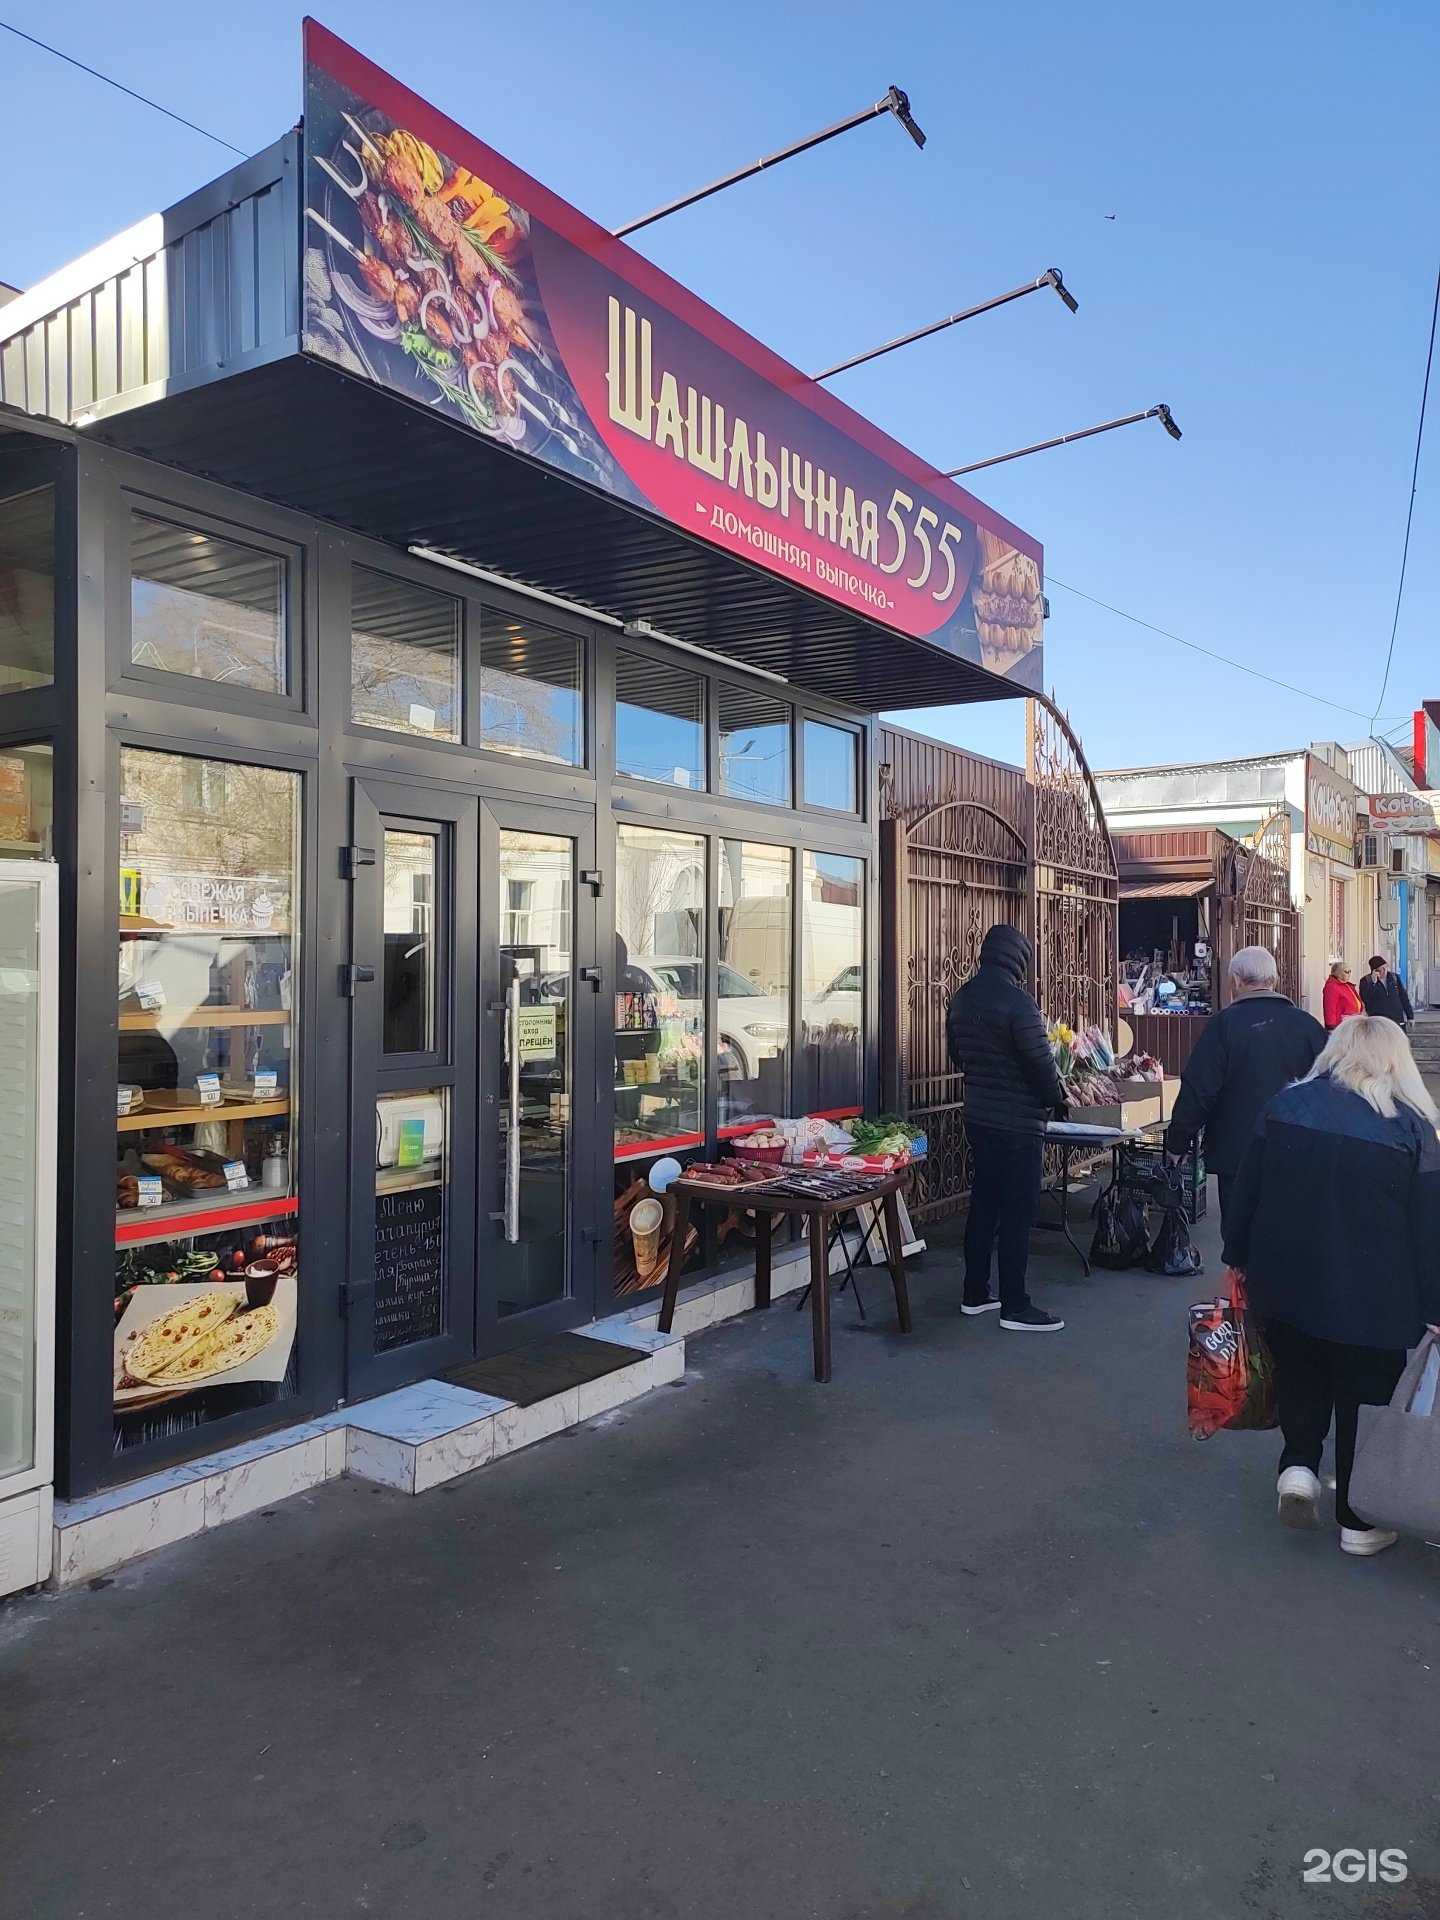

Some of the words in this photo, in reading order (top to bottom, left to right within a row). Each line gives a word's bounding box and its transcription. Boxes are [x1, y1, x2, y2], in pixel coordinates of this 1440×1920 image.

[605, 296, 879, 566] ШАШЛЫЧНАЯ
[881, 488, 962, 602] 555
[1310, 775, 1353, 842] КОНФЕТЫ
